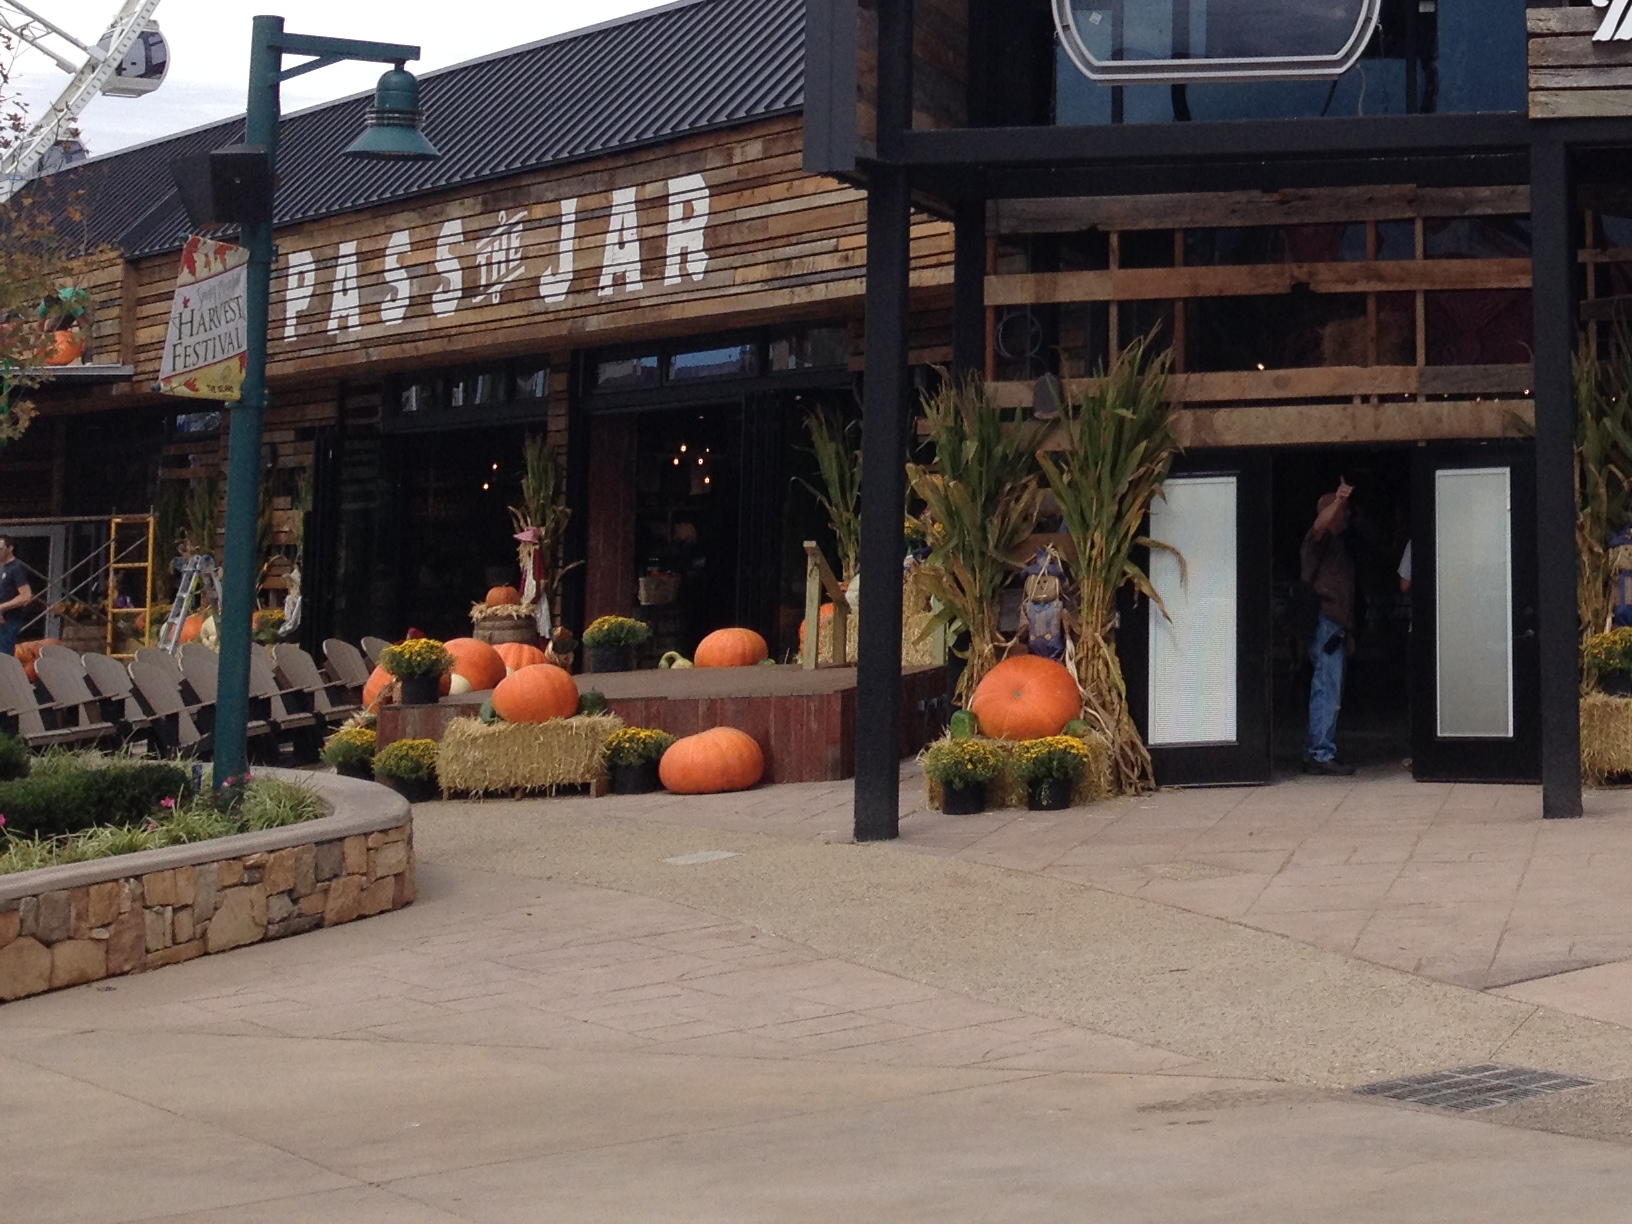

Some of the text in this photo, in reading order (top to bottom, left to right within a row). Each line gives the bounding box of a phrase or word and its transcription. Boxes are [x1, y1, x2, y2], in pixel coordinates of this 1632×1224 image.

[284, 173, 709, 342] PASS THE JAR
[172, 295, 246, 341] HARVEST
[172, 327, 243, 372] FESTIVAL
